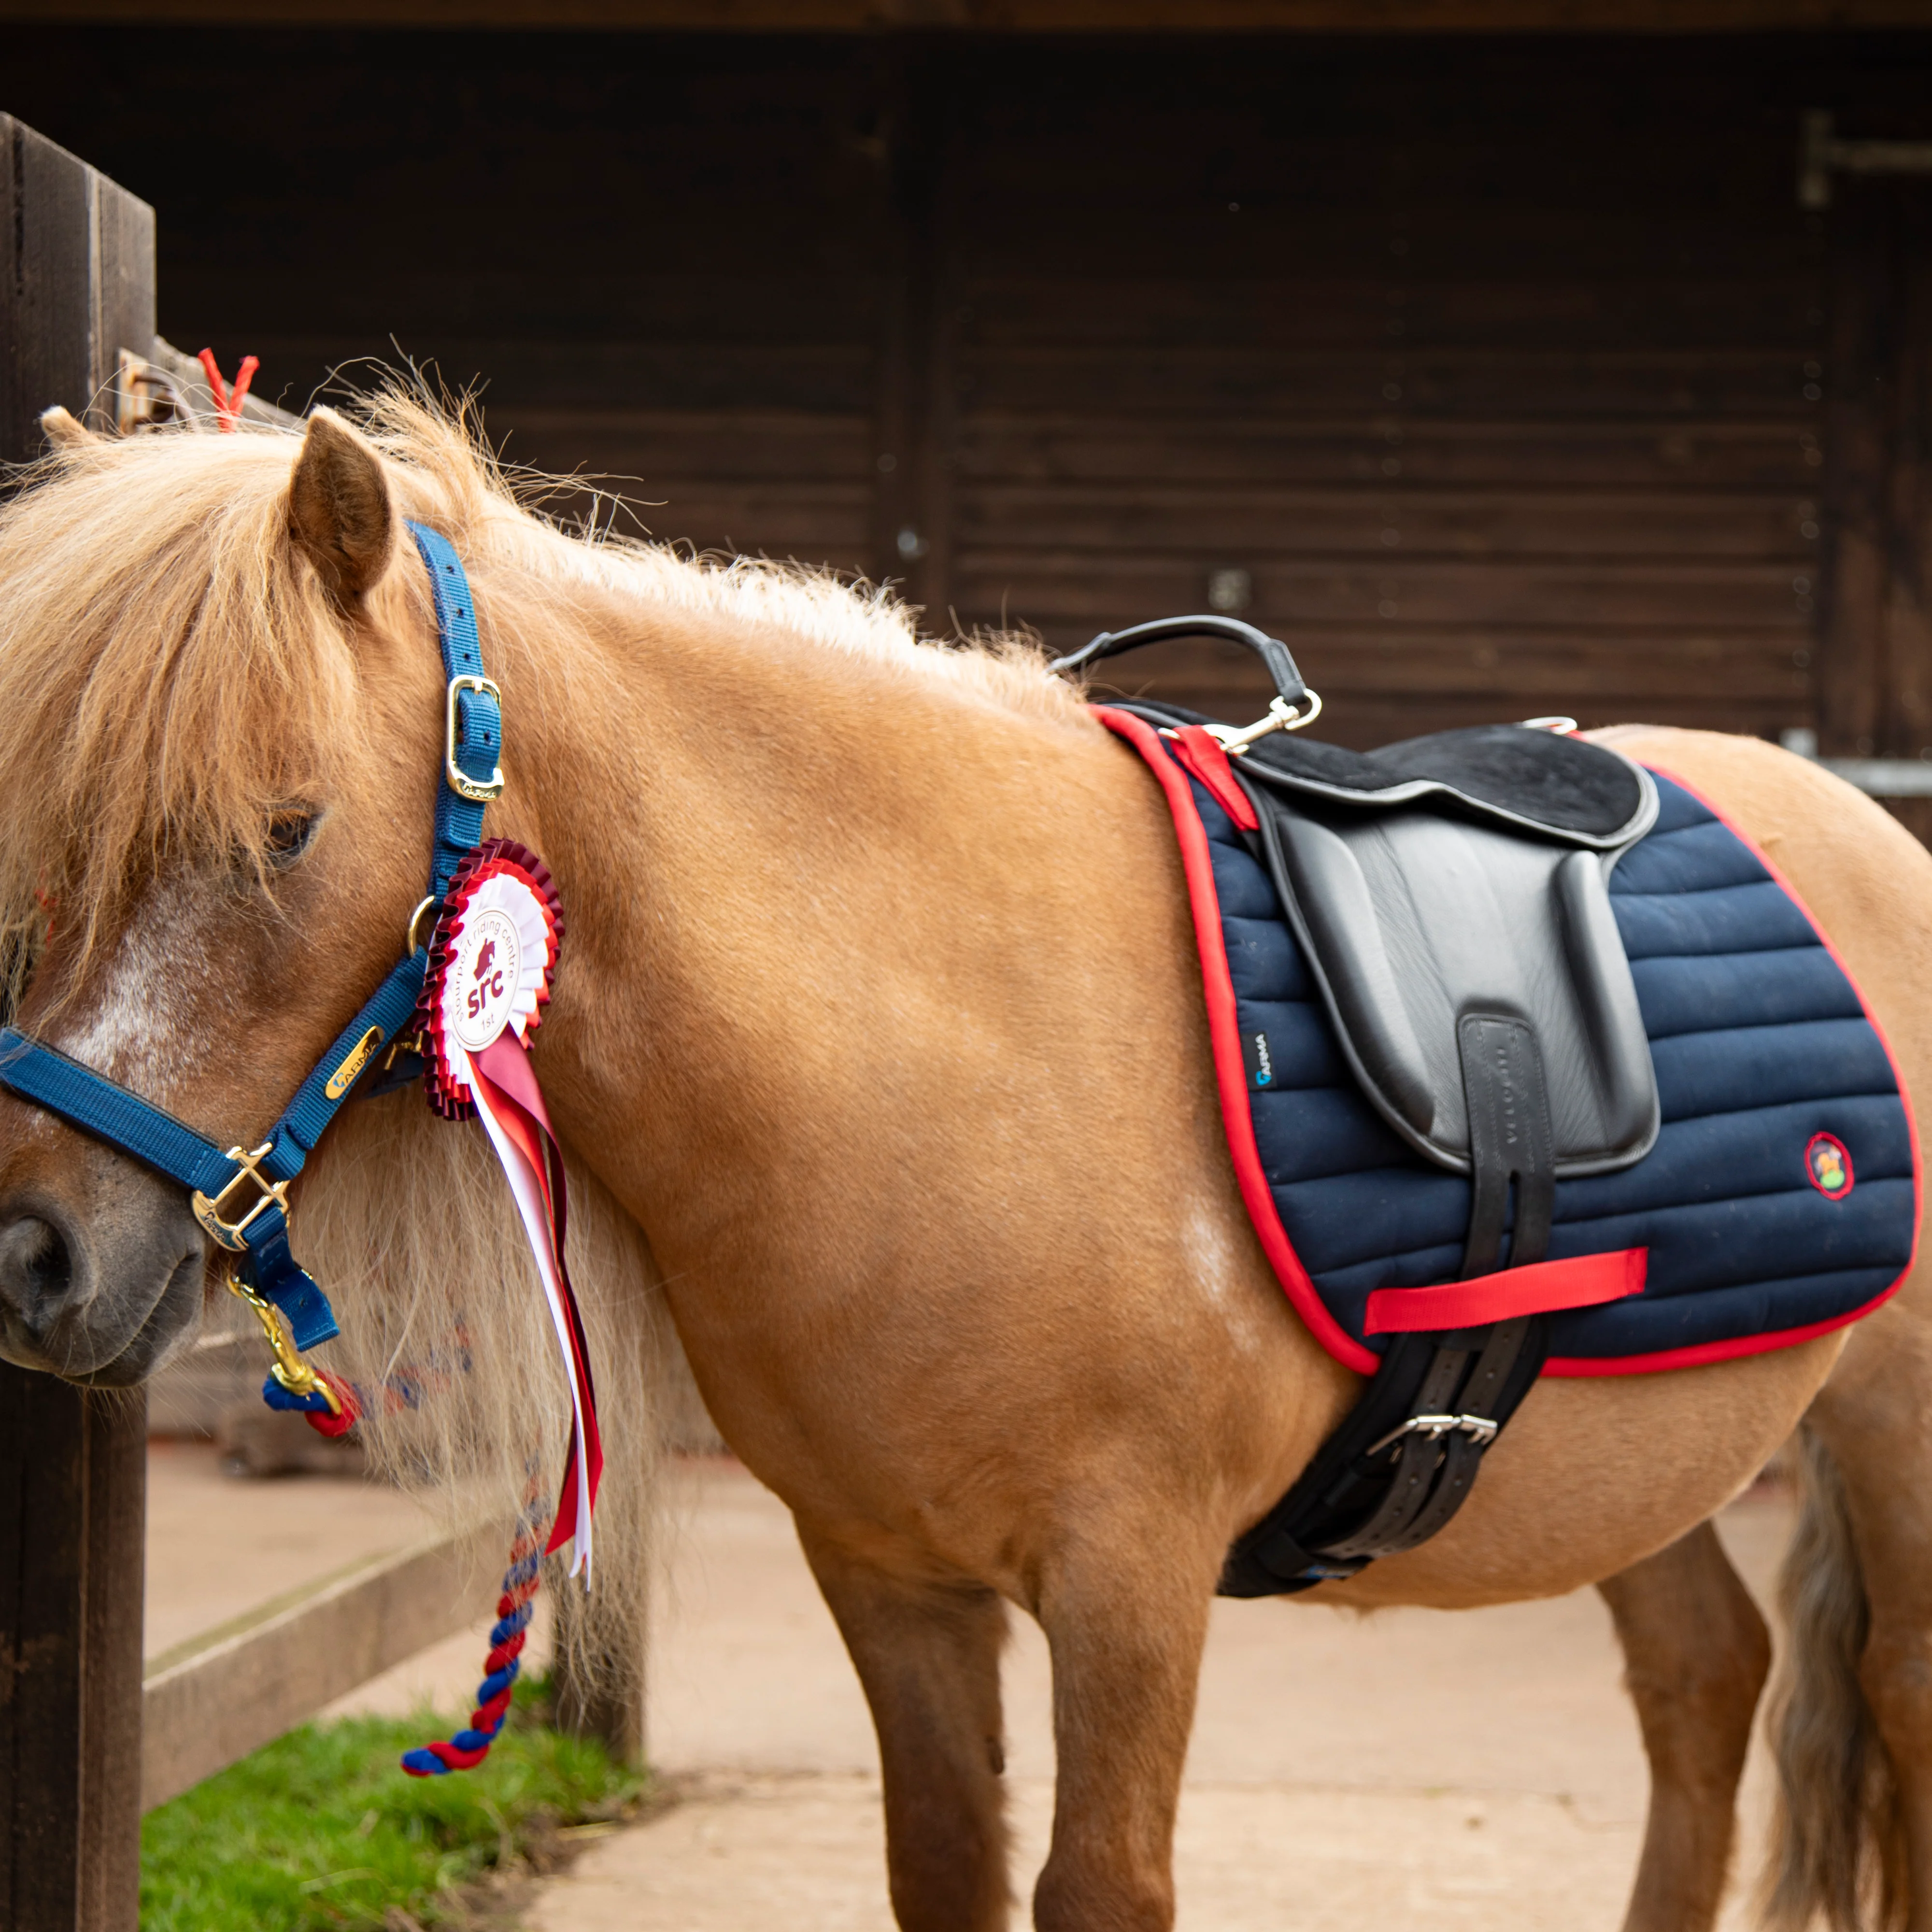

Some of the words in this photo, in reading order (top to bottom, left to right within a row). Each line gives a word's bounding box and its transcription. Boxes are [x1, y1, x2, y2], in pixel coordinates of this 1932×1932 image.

[455, 939, 472, 1022] stourport
[473, 920, 500, 940] riding
[502, 929, 517, 979] centre
[468, 970, 504, 1019] src
[481, 1014, 494, 1030] 1st
